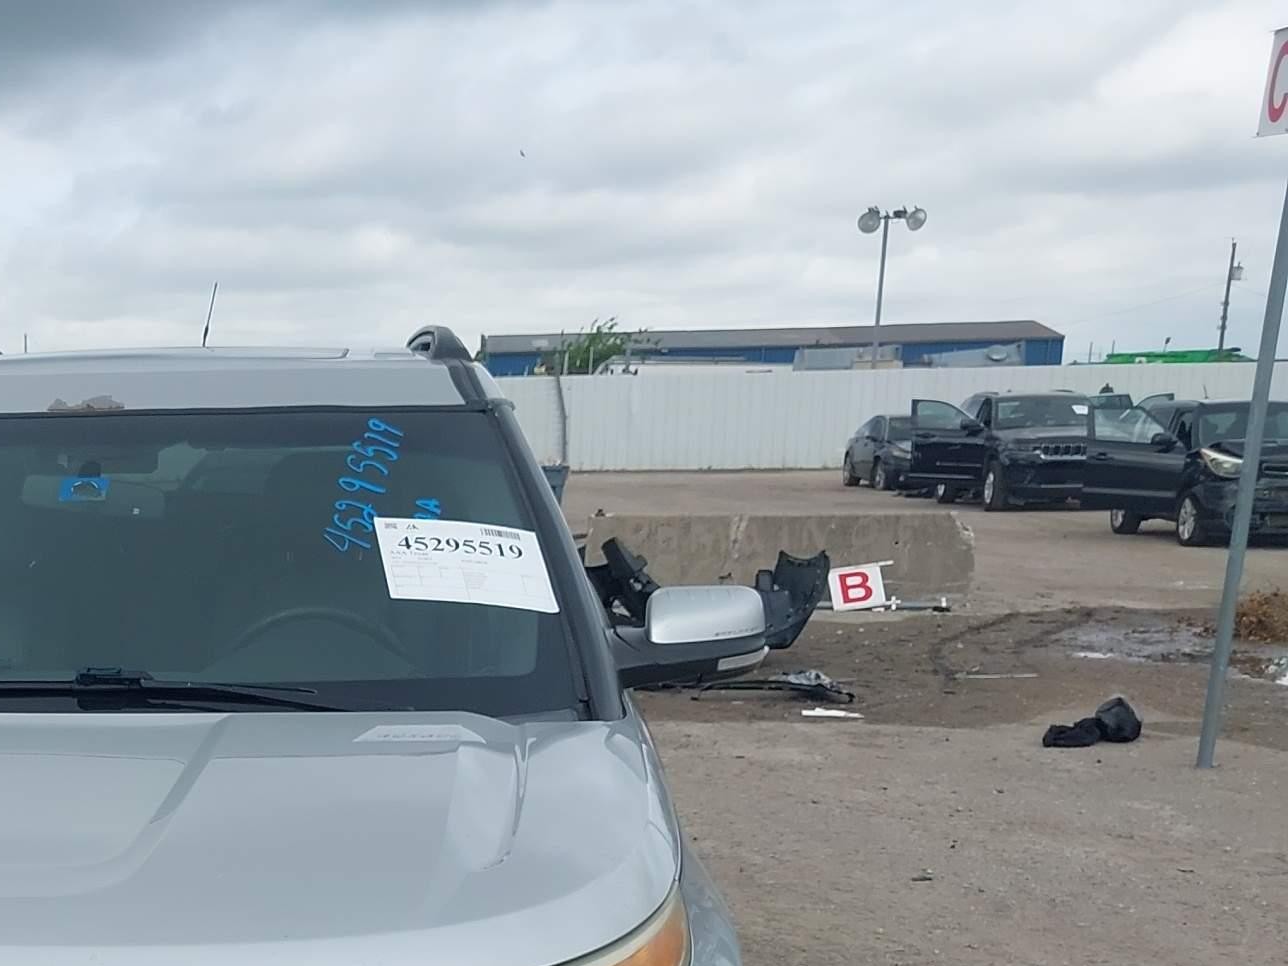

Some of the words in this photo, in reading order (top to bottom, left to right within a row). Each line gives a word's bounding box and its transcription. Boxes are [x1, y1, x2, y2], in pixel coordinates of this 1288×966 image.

[324, 418, 404, 552] 45295519
[397, 536, 524, 560] 45295519
[838, 571, 873, 605] B
